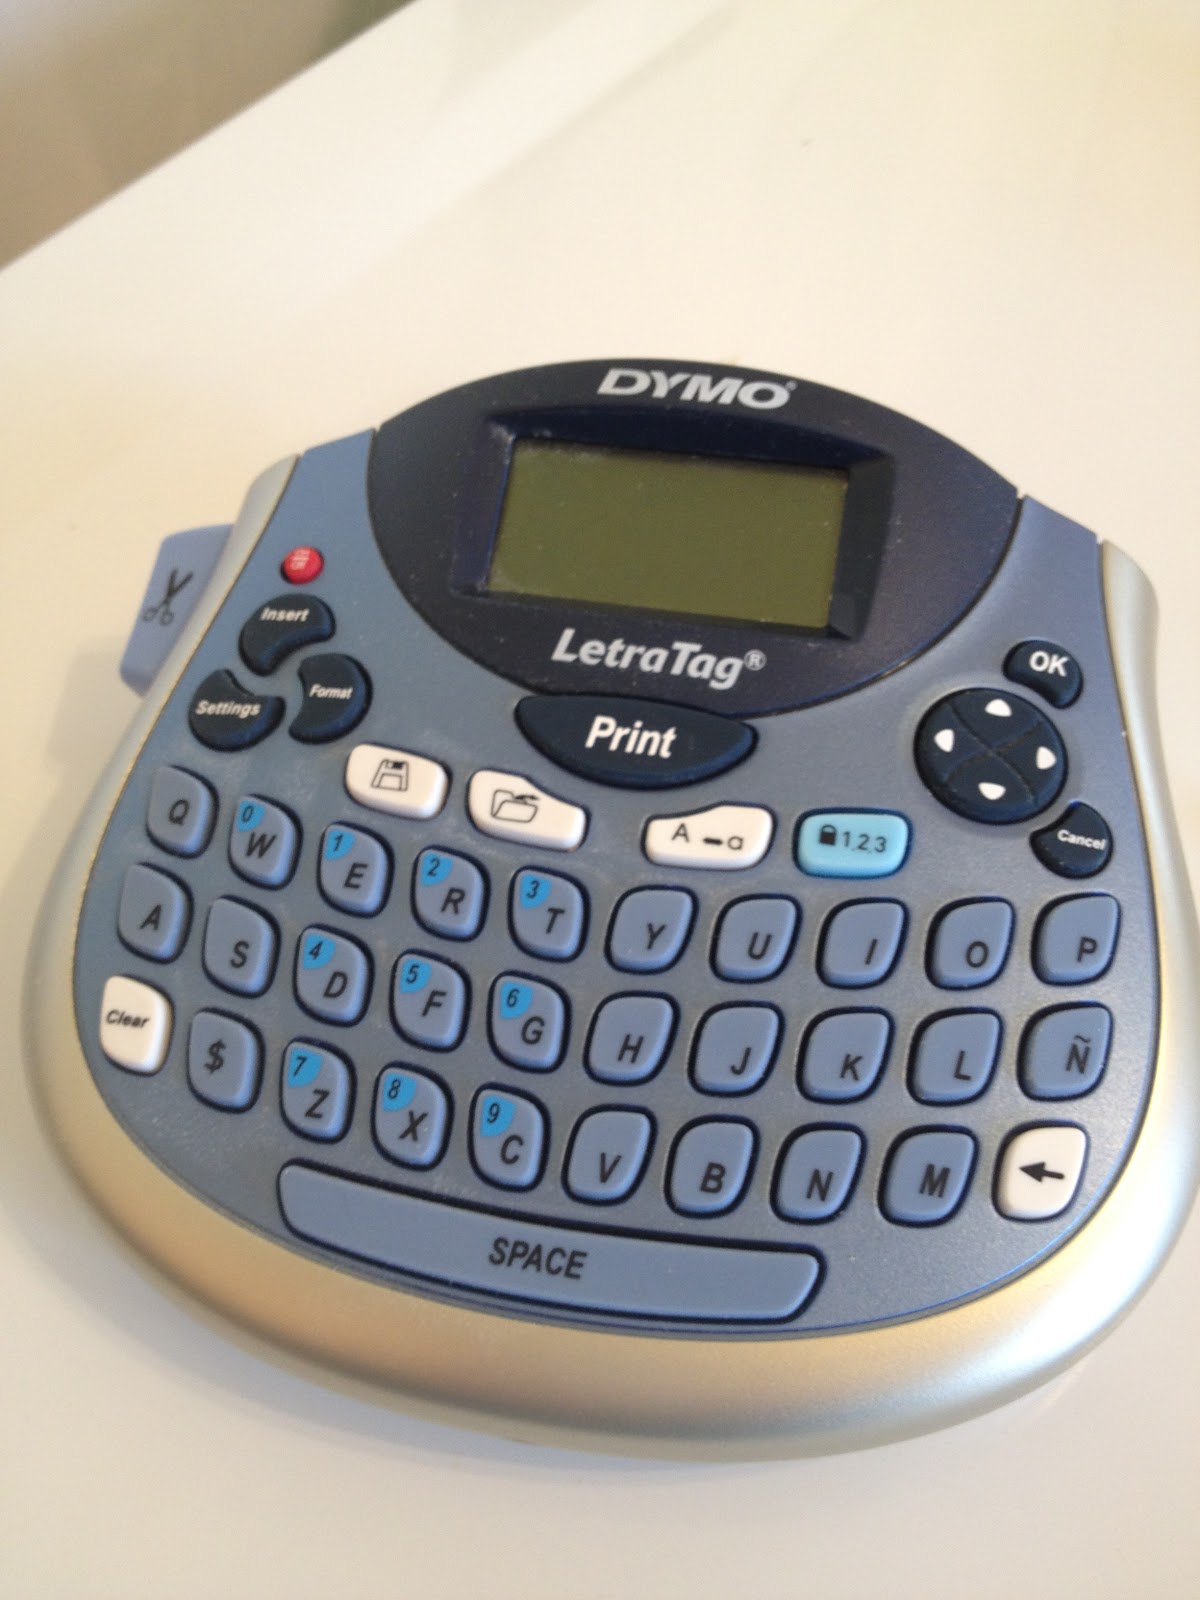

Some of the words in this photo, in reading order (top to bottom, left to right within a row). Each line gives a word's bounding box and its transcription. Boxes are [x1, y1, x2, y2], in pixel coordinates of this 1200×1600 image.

[261, 607, 309, 622] Insert
[1029, 651, 1067, 677] OK
[310, 686, 352, 700] Format
[196, 701, 260, 717] Settings
[585, 716, 677, 758] Print
[168, 799, 187, 826] Q
[242, 806, 255, 823] 0
[333, 834, 343, 851] 1
[672, 823, 690, 842] A
[1057, 830, 1106, 850] Cancel
[247, 834, 274, 858] W
[345, 864, 367, 888] E
[427, 858, 440, 876] 2
[442, 889, 465, 914] R
[525, 881, 539, 898] 3
[140, 904, 162, 930] A
[545, 908, 564, 934] T
[646, 923, 665, 950] Y
[748, 933, 772, 960] U
[230, 941, 249, 968] S
[309, 942, 322, 960] 4
[865, 938, 878, 964] I
[966, 941, 989, 967] O
[1077, 937, 1098, 963] P
[324, 972, 347, 998] D
[406, 965, 419, 983] 5
[422, 991, 445, 1017] F
[506, 989, 518, 1007] 6
[106, 1009, 150, 1029] Clear
[521, 1016, 545, 1044] G
[206, 1040, 225, 1074] $
[618, 1035, 643, 1063] H
[731, 1049, 751, 1075] J
[1066, 1036, 1091, 1074] Ñ
[295, 1057, 307, 1076] 7
[840, 1054, 863, 1081] K
[954, 1051, 972, 1080] L
[388, 1080, 401, 1099] 8
[306, 1090, 329, 1118] Z
[486, 1104, 500, 1123] 9
[400, 1111, 427, 1141] X
[500, 1136, 524, 1164] C
[598, 1154, 621, 1183] V
[701, 1163, 725, 1192] B
[920, 1164, 951, 1197] M
[806, 1171, 832, 1200] N
[488, 1237, 587, 1278] SPACE
